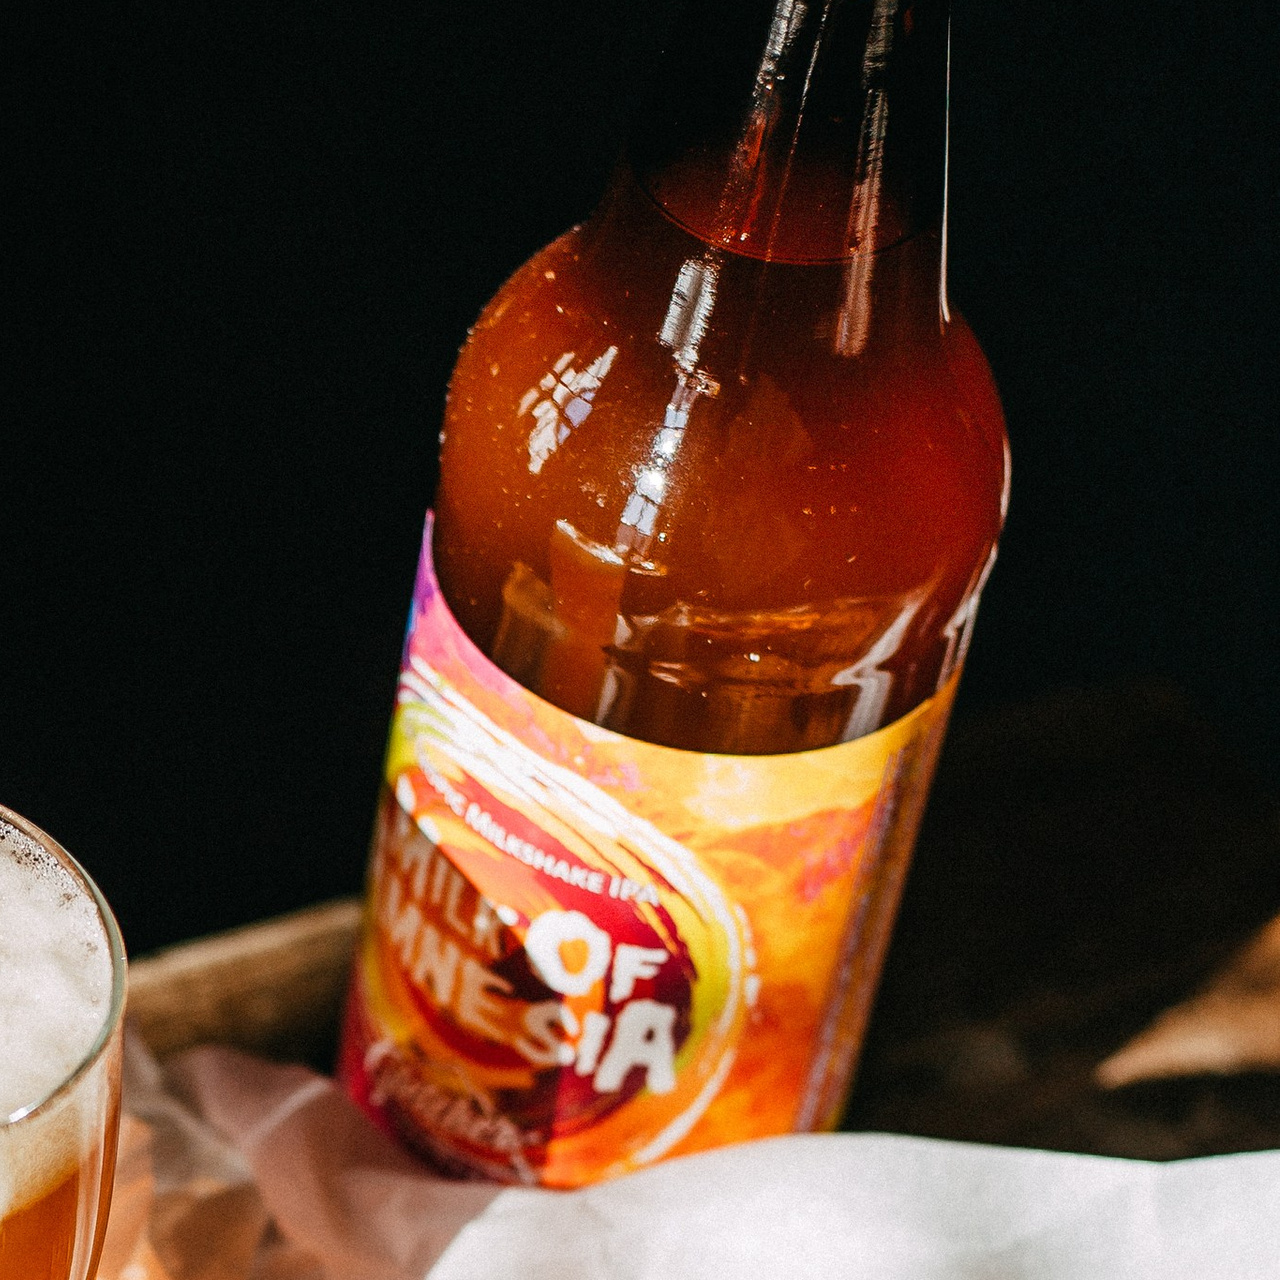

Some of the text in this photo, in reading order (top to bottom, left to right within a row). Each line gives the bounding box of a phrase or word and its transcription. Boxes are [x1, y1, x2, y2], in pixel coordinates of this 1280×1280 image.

[375, 773, 520, 958] MILK
[524, 909, 669, 1003] OF
[375, 870, 678, 1095] MNESIA
[609, 874, 661, 908] IPA
